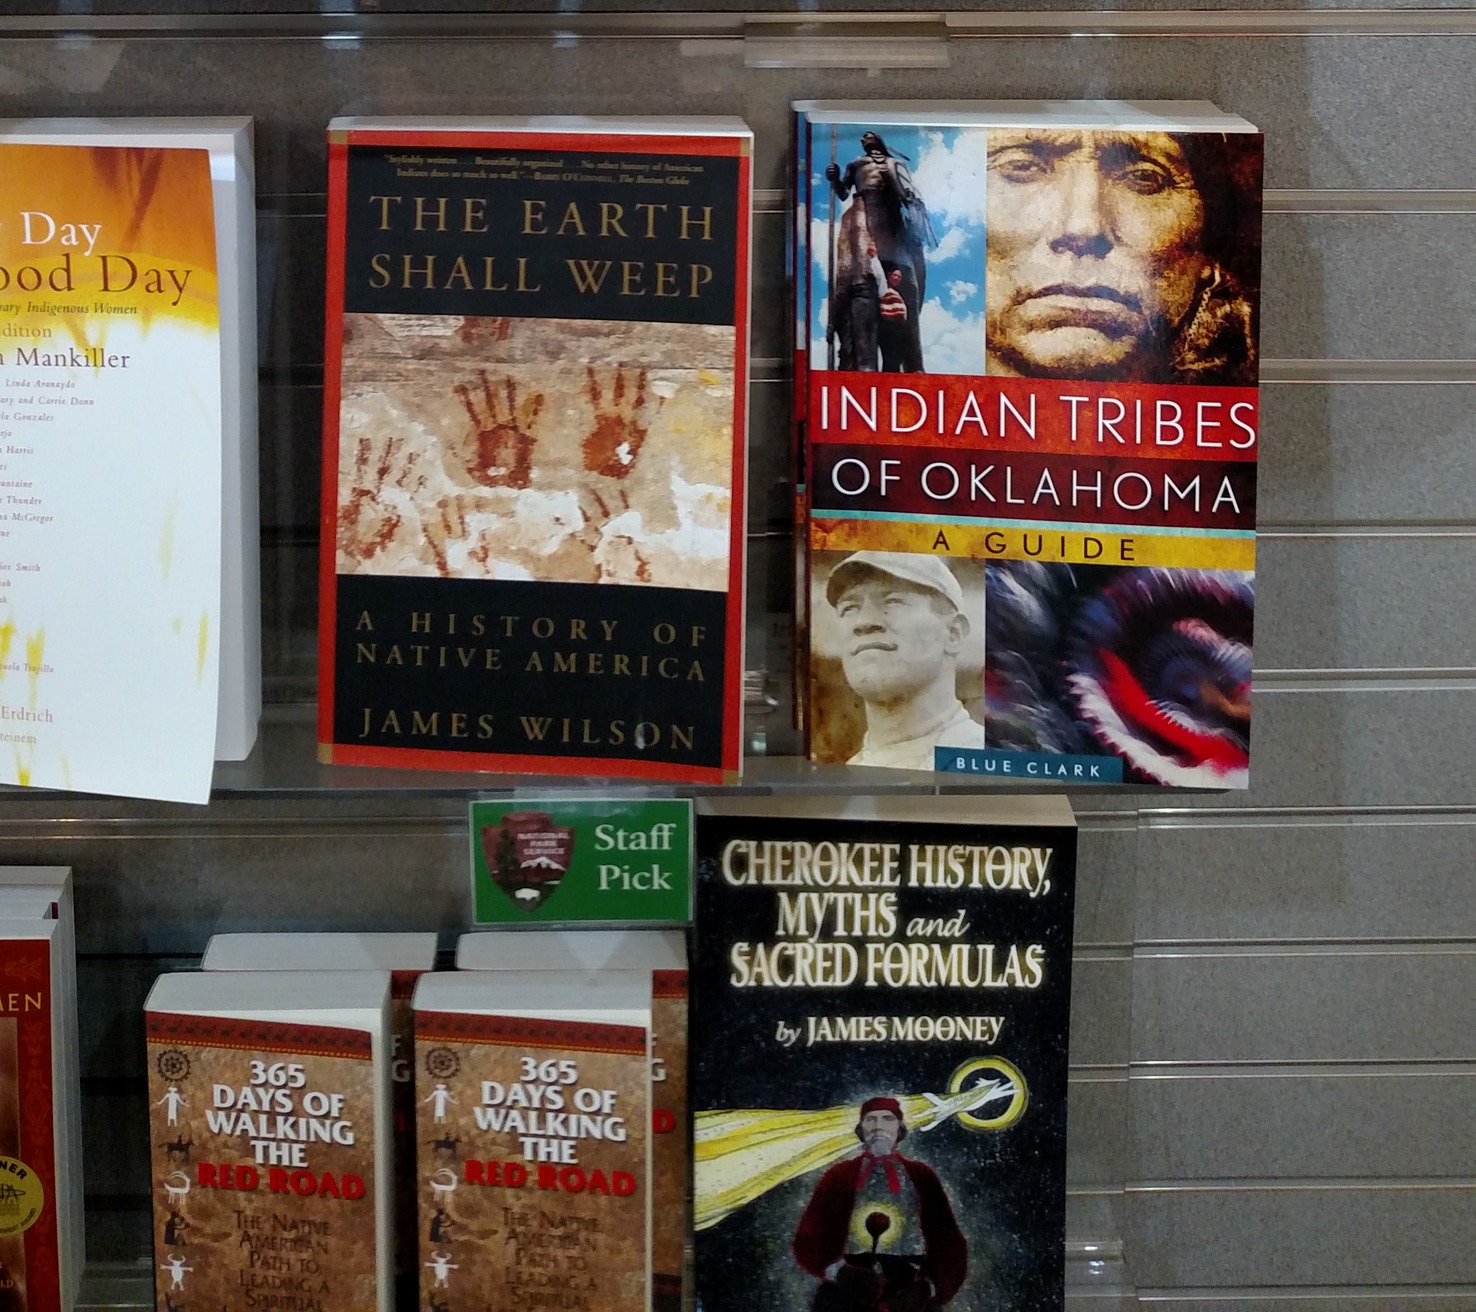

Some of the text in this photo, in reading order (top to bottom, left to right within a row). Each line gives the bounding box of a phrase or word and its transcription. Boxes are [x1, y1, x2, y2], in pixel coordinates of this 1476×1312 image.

[20, 210, 103, 257] Day
[369, 194, 715, 241] THE EARTH
[97, 254, 193, 307] Day
[368, 252, 714, 299] SHALL WEEP
[27, 300, 90, 317] Indigenous
[93, 302, 138, 315] Women
[0, 322, 53, 338] dition
[16, 346, 131, 369] Mankiller
[5, 378, 31, 388] Linda
[13, 411, 54, 422] Gonzales
[18, 395, 34, 405] and
[70, 396, 95, 406] Dann
[820, 384, 1257, 450] INDIAN TRIBES
[6, 445, 34, 455] Harris
[6, 495, 43, 505] Thunder
[830, 457, 1241, 515] OF OKLAHOMA
[932, 529, 1136, 561] A GUIDE
[15, 562, 41, 572] Smith
[355, 609, 706, 647] A HISTORY OF
[356, 642, 706, 682] NATIVE AMERICA
[1, 705, 54, 724] Erdrich
[359, 707, 695, 751] JAMES WILSON
[955, 756, 1100, 778] BLUE CLARK
[594, 822, 678, 851] Staff
[597, 863, 673, 891] Pick
[721, 838, 1054, 899] CHEROKEE HISTORY,
[775, 890, 972, 943] MYTHS and
[729, 941, 1047, 989] SACRED FORMULAS
[0, 991, 42, 1013] EN
[774, 1015, 1006, 1047] by JAMES MOONEY
[249, 1059, 307, 1089] 365
[519, 1056, 580, 1085] 365
[212, 1083, 346, 1119] DAYS OF
[480, 1080, 618, 1115] DAYS OF
[204, 1109, 357, 1146] WALKING
[473, 1106, 628, 1143] WALKING
[250, 1139, 310, 1169] THE
[518, 1136, 580, 1165] THE
[196, 1160, 367, 1200] RED ROAD
[464, 1158, 637, 1198] RED ROAD
